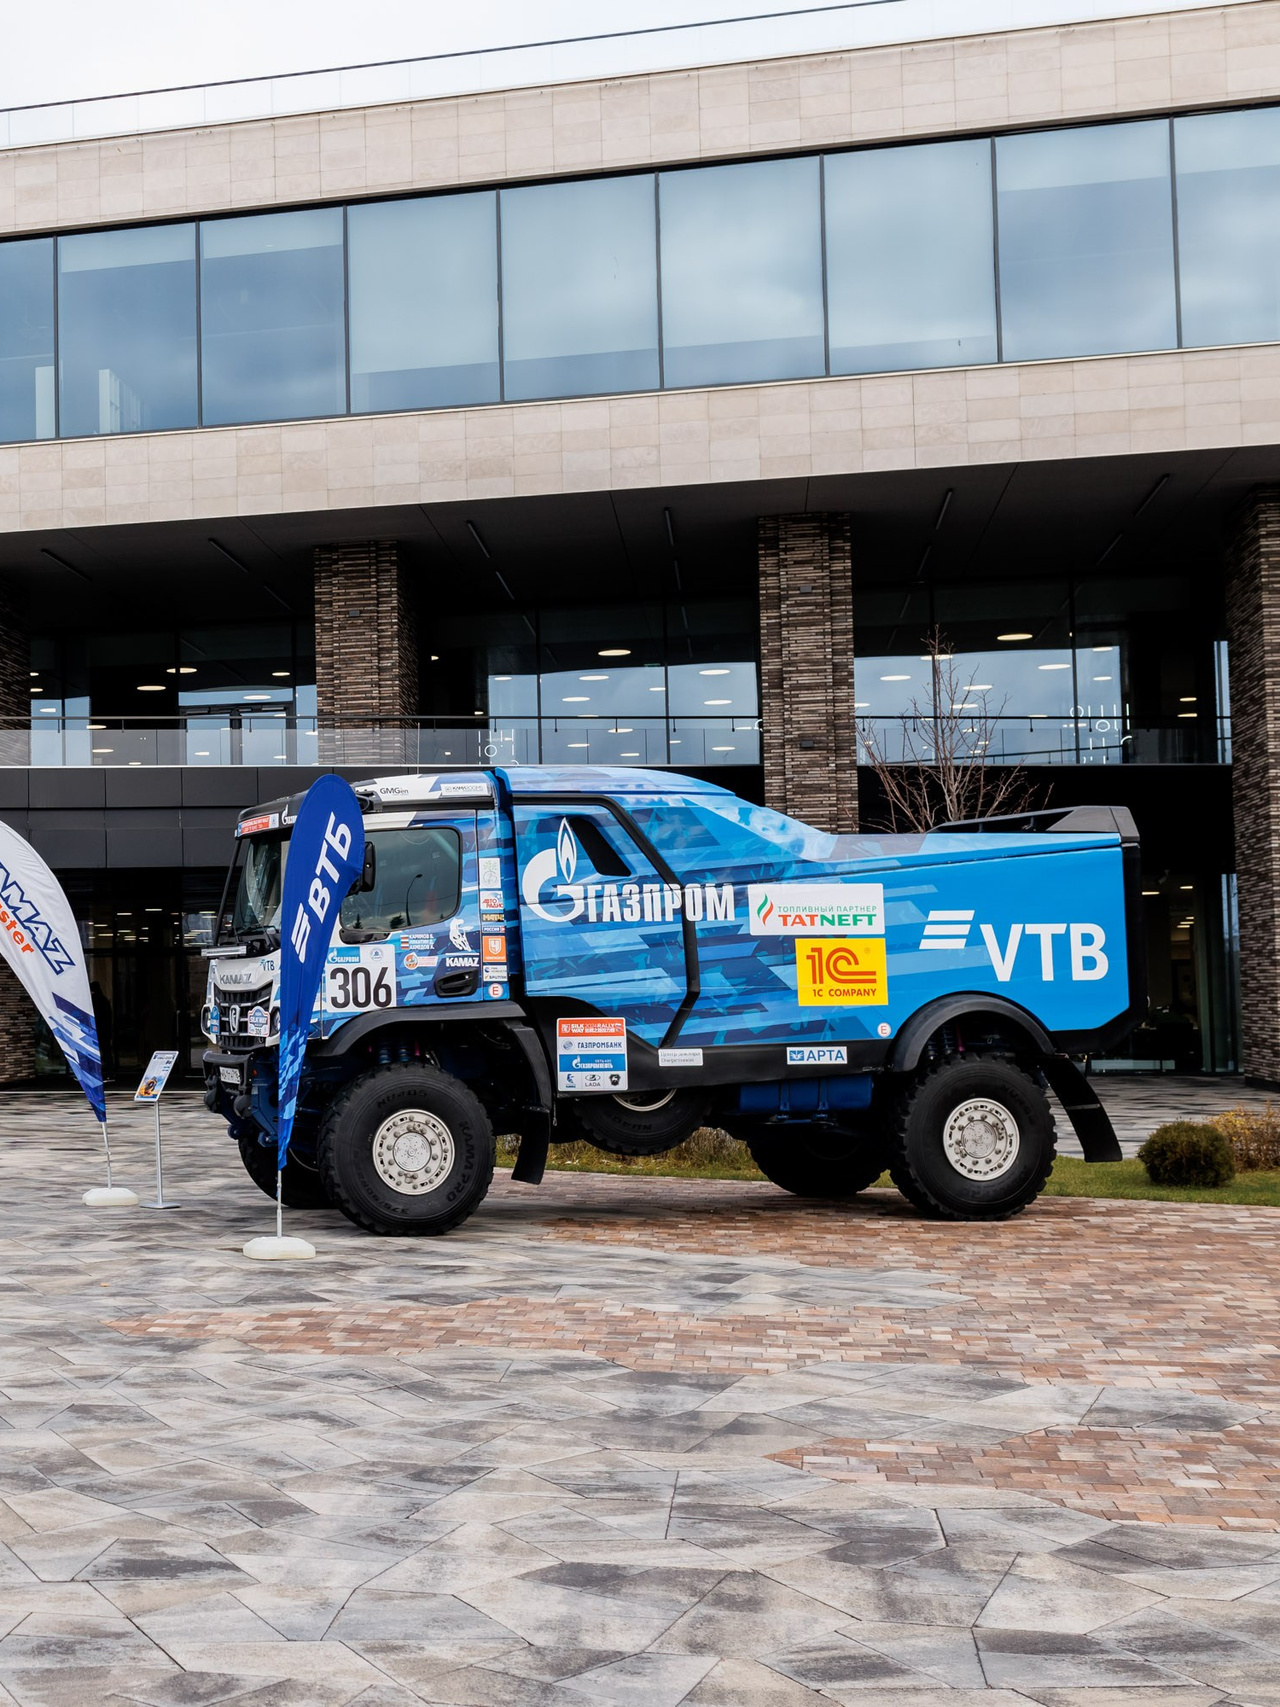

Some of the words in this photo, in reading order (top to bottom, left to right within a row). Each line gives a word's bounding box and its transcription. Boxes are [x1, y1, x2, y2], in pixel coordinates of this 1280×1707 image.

[307, 811, 352, 924] ВТБ
[587, 883, 735, 923] ГАЗПРОМ
[778, 904, 834, 913] ТОПЛИВНЫЙ
[836, 904, 877, 913] ПАРТНЕР
[778, 914, 877, 926] TATNEFT
[979, 923, 1109, 982] VTB
[262, 960, 275, 971] VTB
[445, 957, 480, 967] KAMAZ
[329, 967, 392, 1009] 306
[492, 986, 499, 996] E
[828, 988, 877, 997] COMPANY
[880, 1025, 888, 1034] E
[577, 1041, 622, 1049] ГАЗПРОМБАНК
